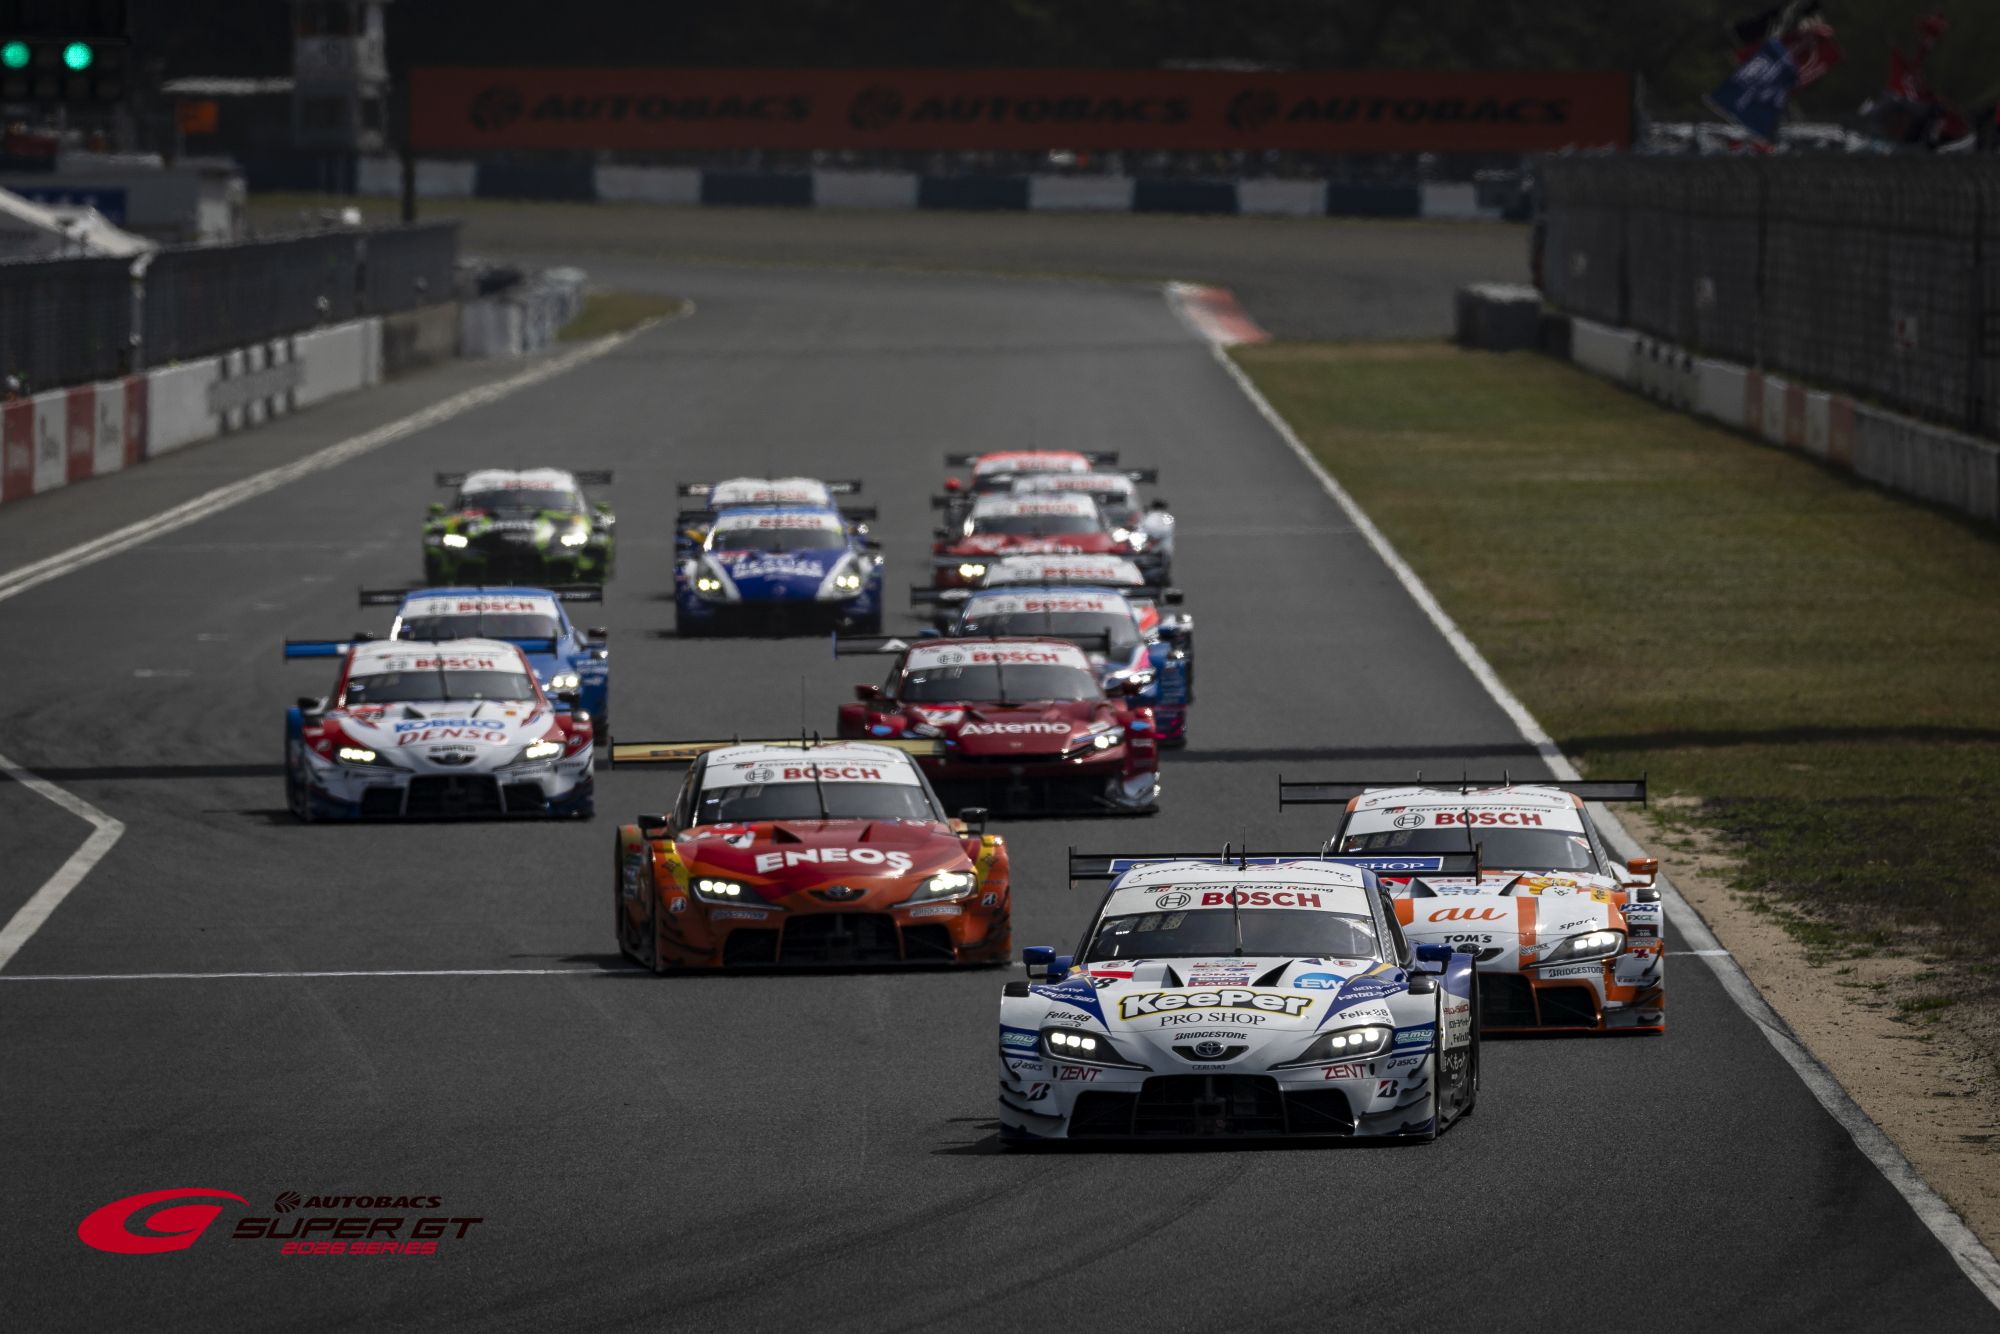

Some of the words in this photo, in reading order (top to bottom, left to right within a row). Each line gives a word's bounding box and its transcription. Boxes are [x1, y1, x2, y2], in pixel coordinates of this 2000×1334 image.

[531, 94, 811, 122] AUTOBACS
[910, 94, 1193, 123] AUTOBACS
[1286, 96, 1571, 124] AUTOBACS
[458, 602, 535, 612] BOSCH
[1025, 601, 1103, 611] BOSCH
[415, 659, 494, 669] BOSCH
[971, 652, 1060, 663] BOSCH
[959, 722, 1071, 736] Astemo
[398, 728, 506, 746] DENSO
[784, 767, 881, 779] BOSCH
[1435, 812, 1542, 826] BOSCH
[755, 848, 913, 874] ENEOS
[1287, 885, 1334, 893] Racing
[1201, 891, 1321, 908] BOSCH
[1428, 908, 1508, 922] au
[1444, 933, 1493, 943] TOM'S
[1548, 966, 1605, 977] BRIDGESTONE
[1120, 989, 1312, 1020] KeePer
[1044, 1011, 1092, 1022] Felix88
[1160, 1013, 1204, 1027] PRO
[1207, 1012, 1266, 1026] SHOP
[1339, 1008, 1389, 1020] Felix88
[1174, 1031, 1248, 1041] BRIDGESTONE
[1022, 1061, 1044, 1071] asics
[1397, 1057, 1418, 1066] asics
[1060, 1065, 1103, 1081] ZENT
[1321, 1063, 1366, 1080] ZENT
